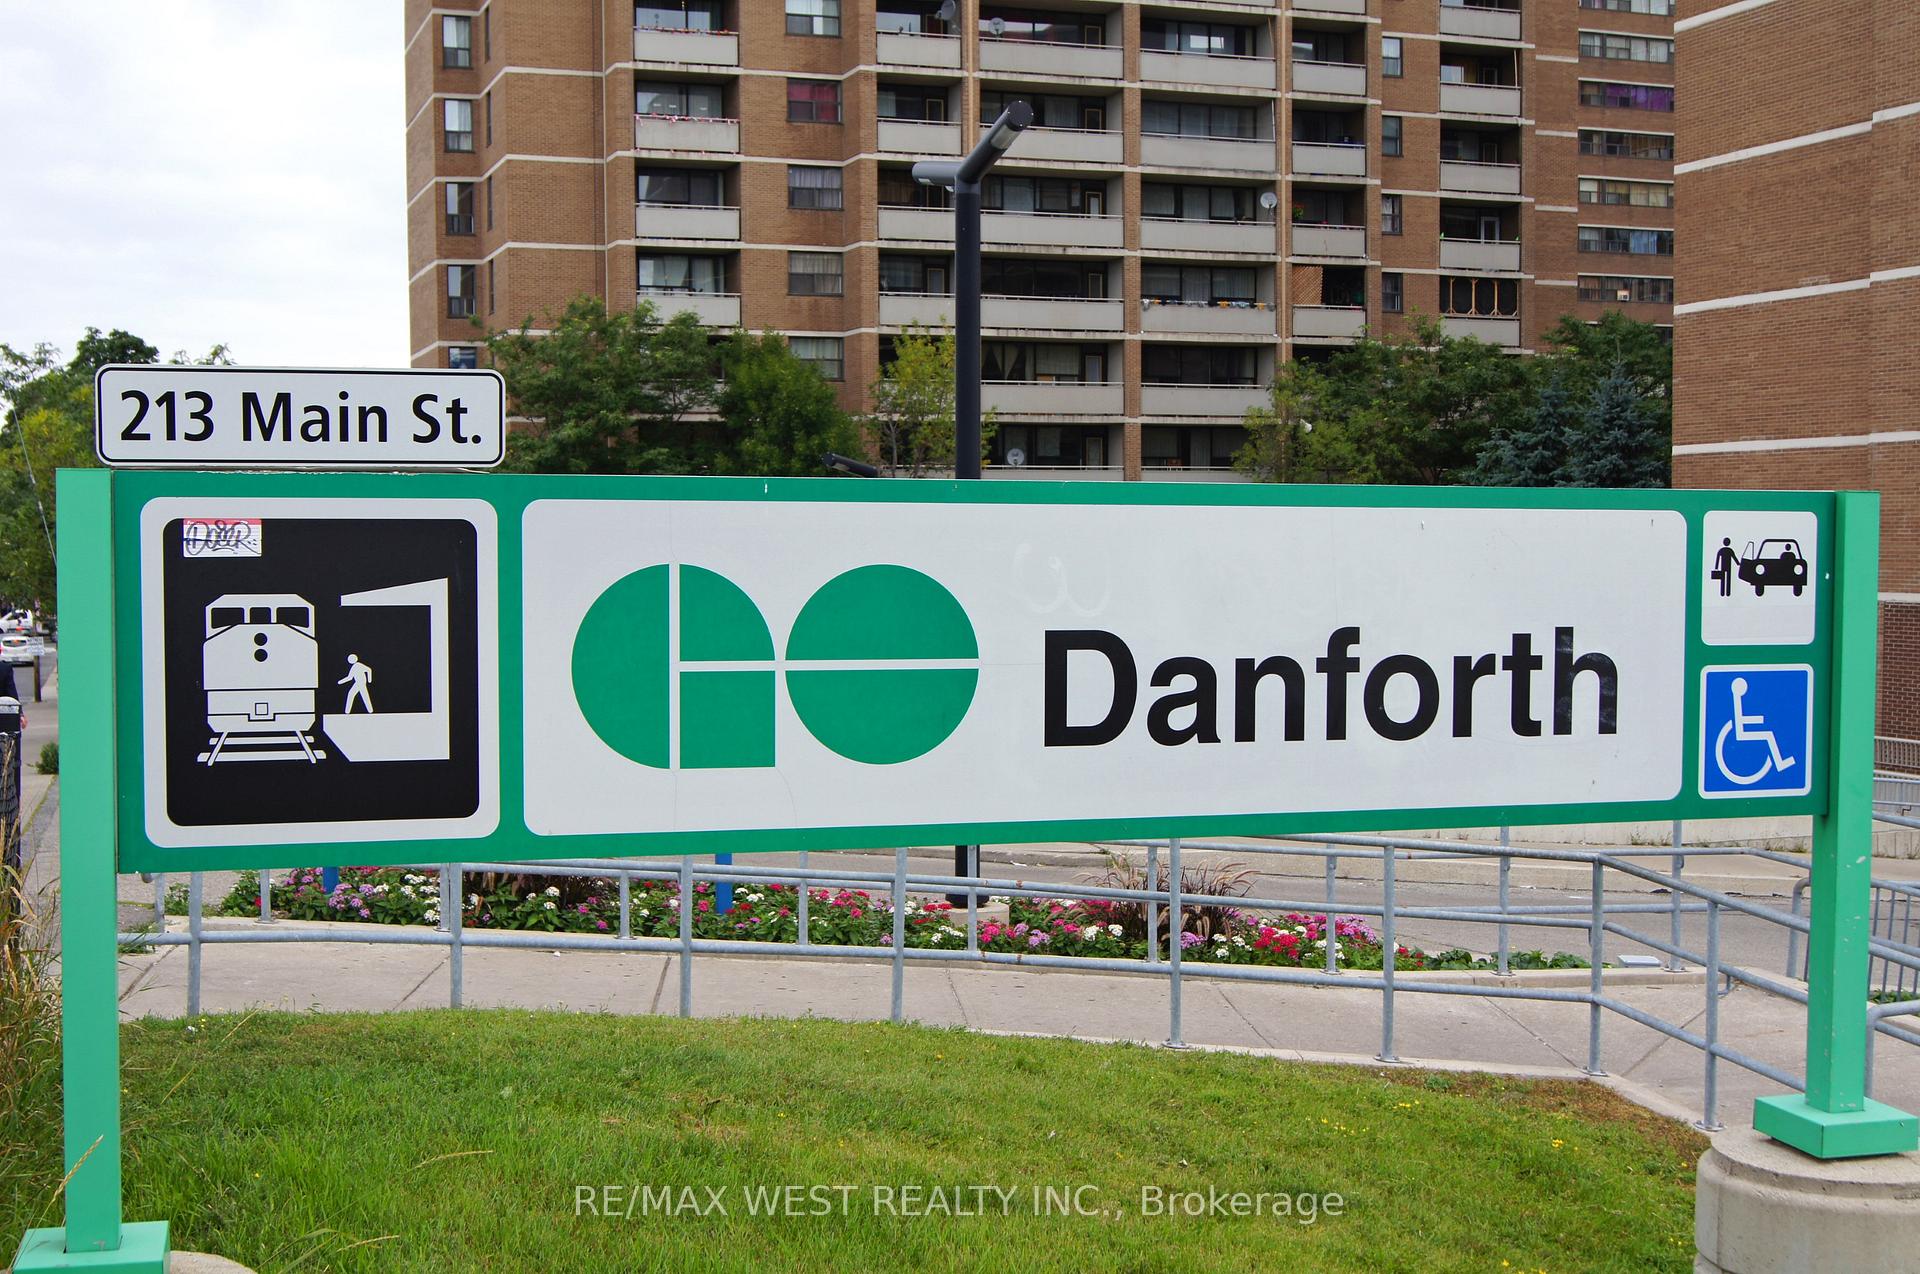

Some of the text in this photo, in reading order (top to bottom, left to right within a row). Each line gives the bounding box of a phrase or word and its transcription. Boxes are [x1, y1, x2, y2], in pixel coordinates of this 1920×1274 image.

[120, 389, 482, 445] 213 Main St.
[571, 563, 1618, 770] GO Danforth
